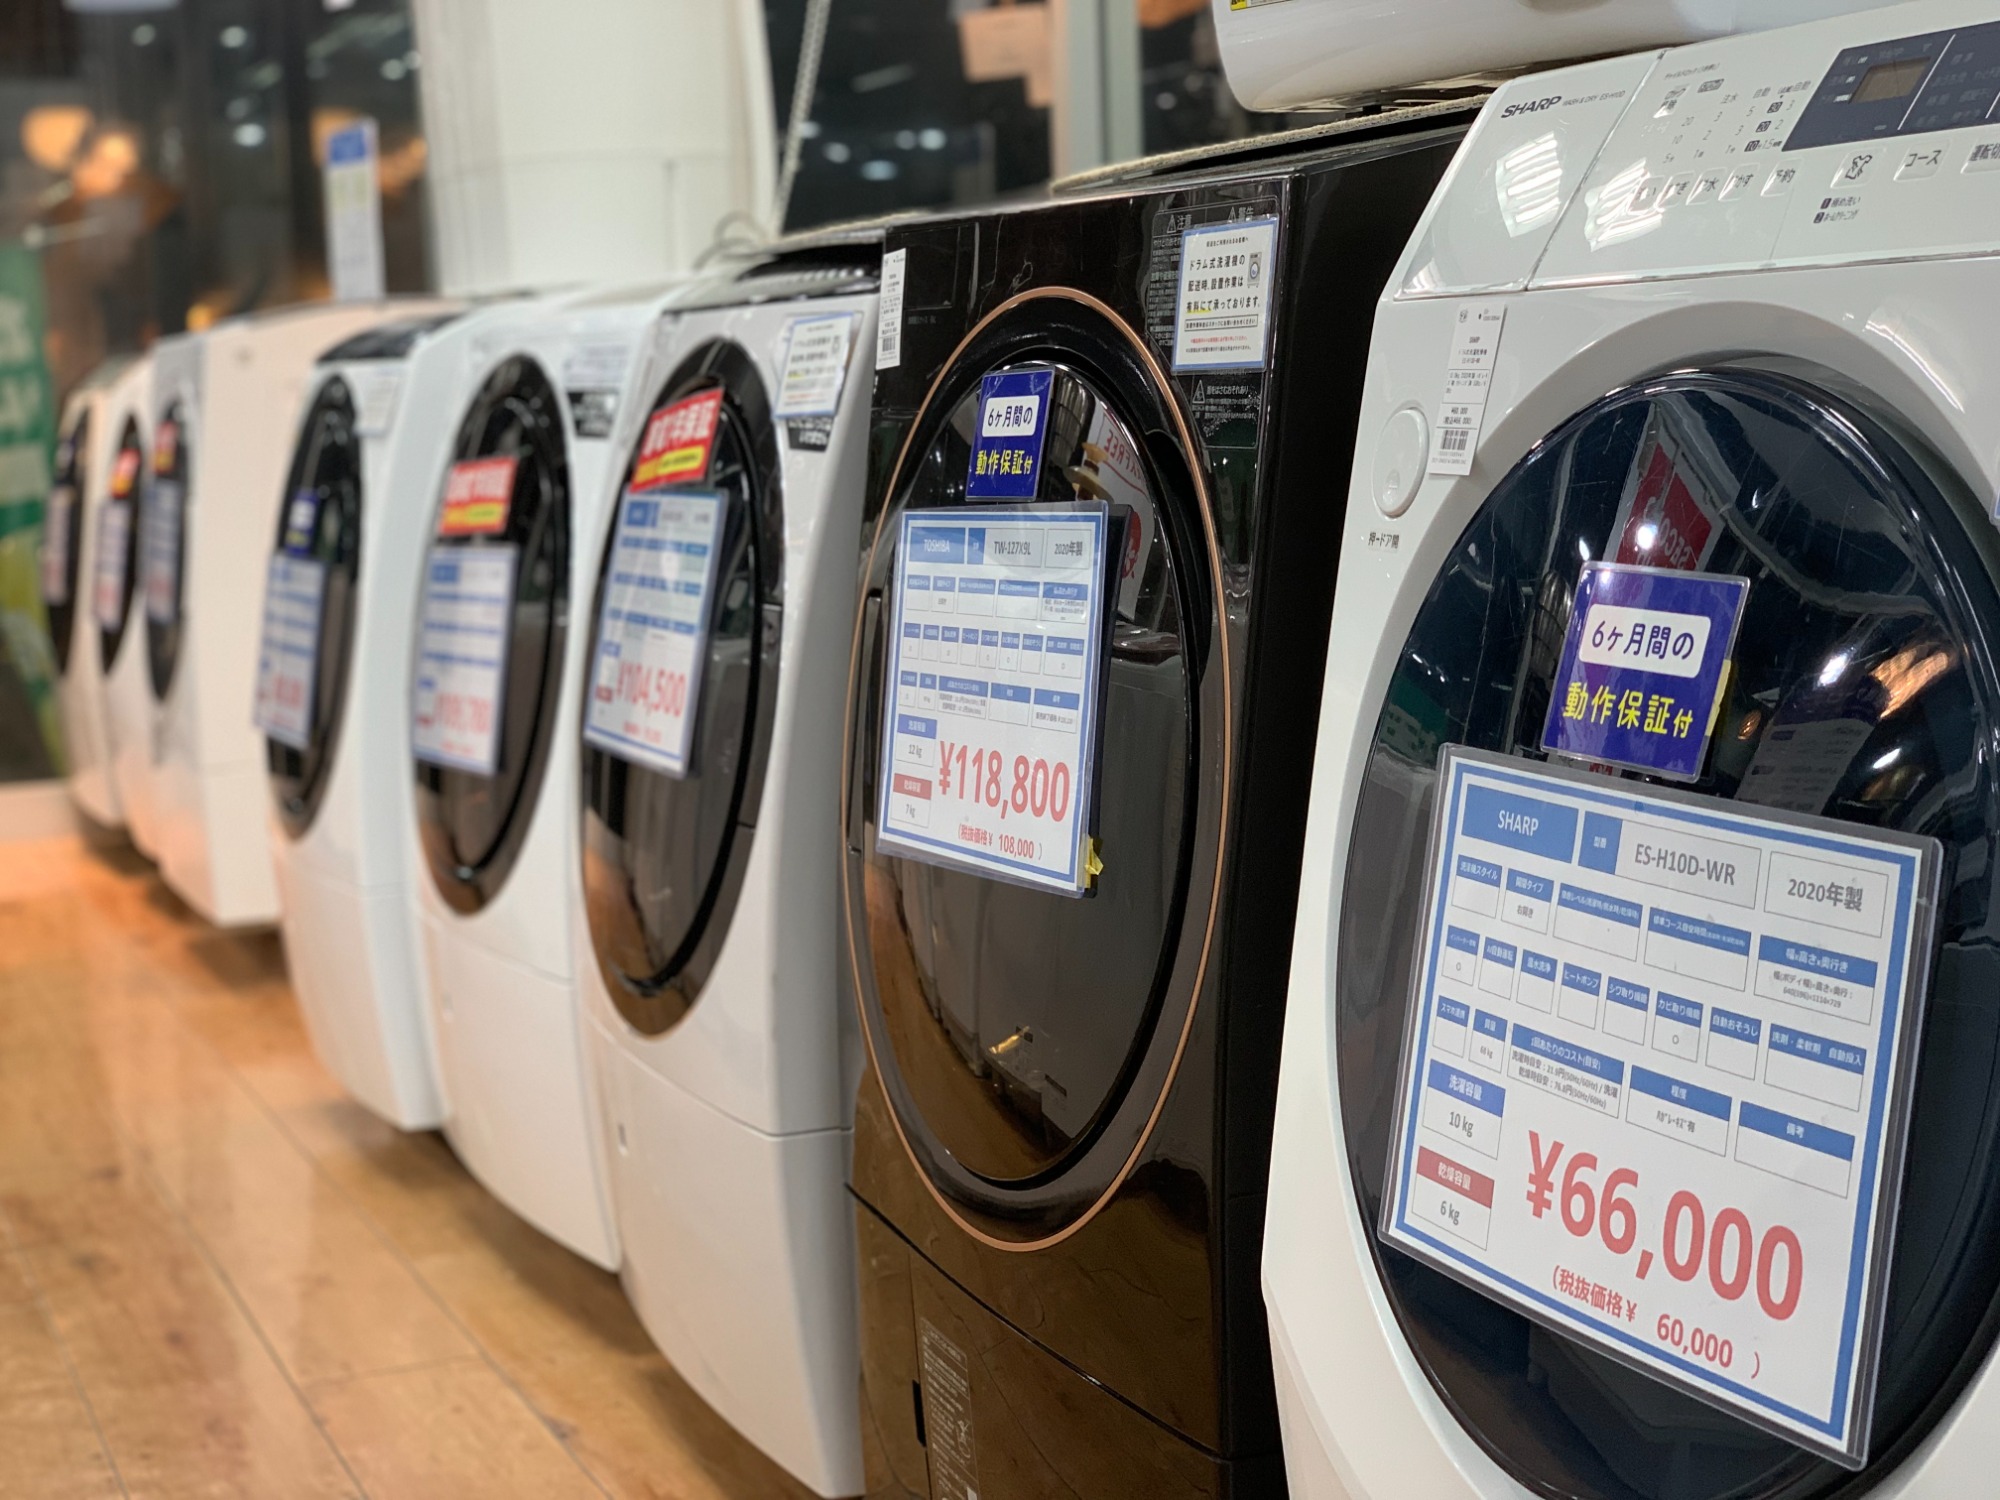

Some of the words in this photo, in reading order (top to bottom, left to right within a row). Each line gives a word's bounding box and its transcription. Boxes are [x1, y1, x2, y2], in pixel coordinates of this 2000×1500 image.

[1501, 96, 1562, 118] SHARP
[1905, 149, 1942, 168] コース
[1190, 254, 1246, 271] ドラム式洗濯機の
[1187, 276, 1244, 292] 配送時、設置作業は
[975, 449, 1034, 476] 動作保証付
[923, 539, 951, 553] TOSHIBA
[1054, 541, 1083, 557] 2020年製
[1562, 681, 1694, 739] 動作保証付
[938, 740, 1070, 823] ¥118,800
[1497, 809, 1540, 838] SHARP
[998, 833, 1035, 859] 108,000
[1633, 843, 1737, 887] ES-H10D-WR
[1787, 878, 1864, 913] 2020年製
[1516, 904, 1535, 920] 右開き
[1563, 968, 1600, 989] ヒートポンプ
[1607, 982, 1648, 1005] シワ取り機能
[1657, 997, 1701, 1021] カビ取り機能
[1711, 1014, 1759, 1037] 自動おそうじ
[1827, 1045, 1863, 1067] 自動投入
[1448, 1073, 1483, 1101] 洗濯容量
[1670, 1084, 1687, 1101] 程度
[1449, 1110, 1461, 1129] 10
[1462, 1116, 1474, 1138] kg
[1786, 1122, 1805, 1139] 備考
[1438, 1162, 1472, 1191] 乾燥容量
[1440, 1200, 1447, 1217] 6
[1448, 1203, 1460, 1227] kg
[1526, 1130, 1804, 1321] ¥66,000
[1656, 1312, 1733, 1369] 60,000
